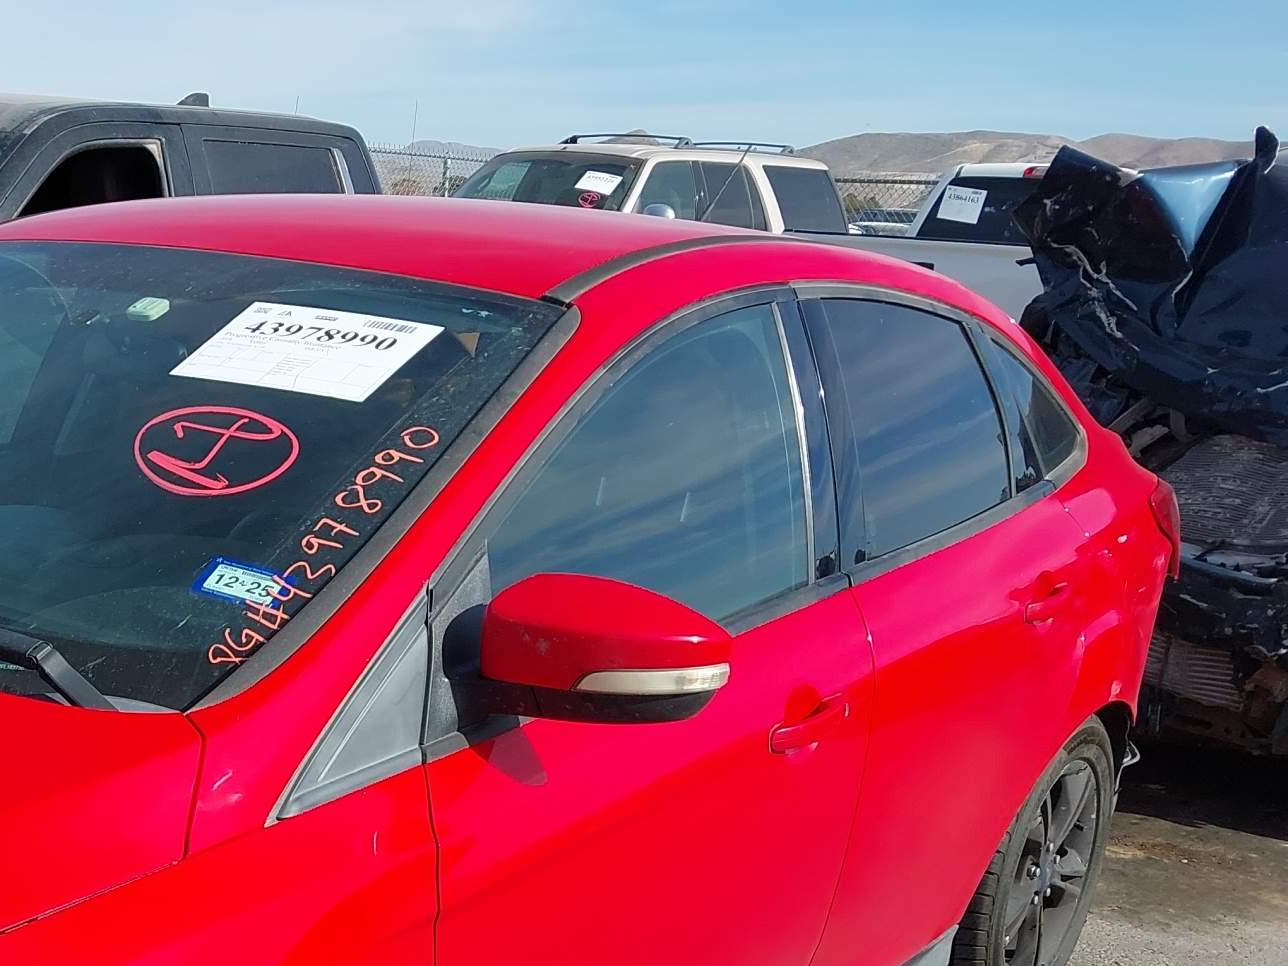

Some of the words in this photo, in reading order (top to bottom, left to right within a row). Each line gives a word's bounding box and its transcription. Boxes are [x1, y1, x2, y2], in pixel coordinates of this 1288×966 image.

[244, 320, 398, 352] 43978990
[214, 573, 240, 589] 12
[244, 581, 275, 598] 25
